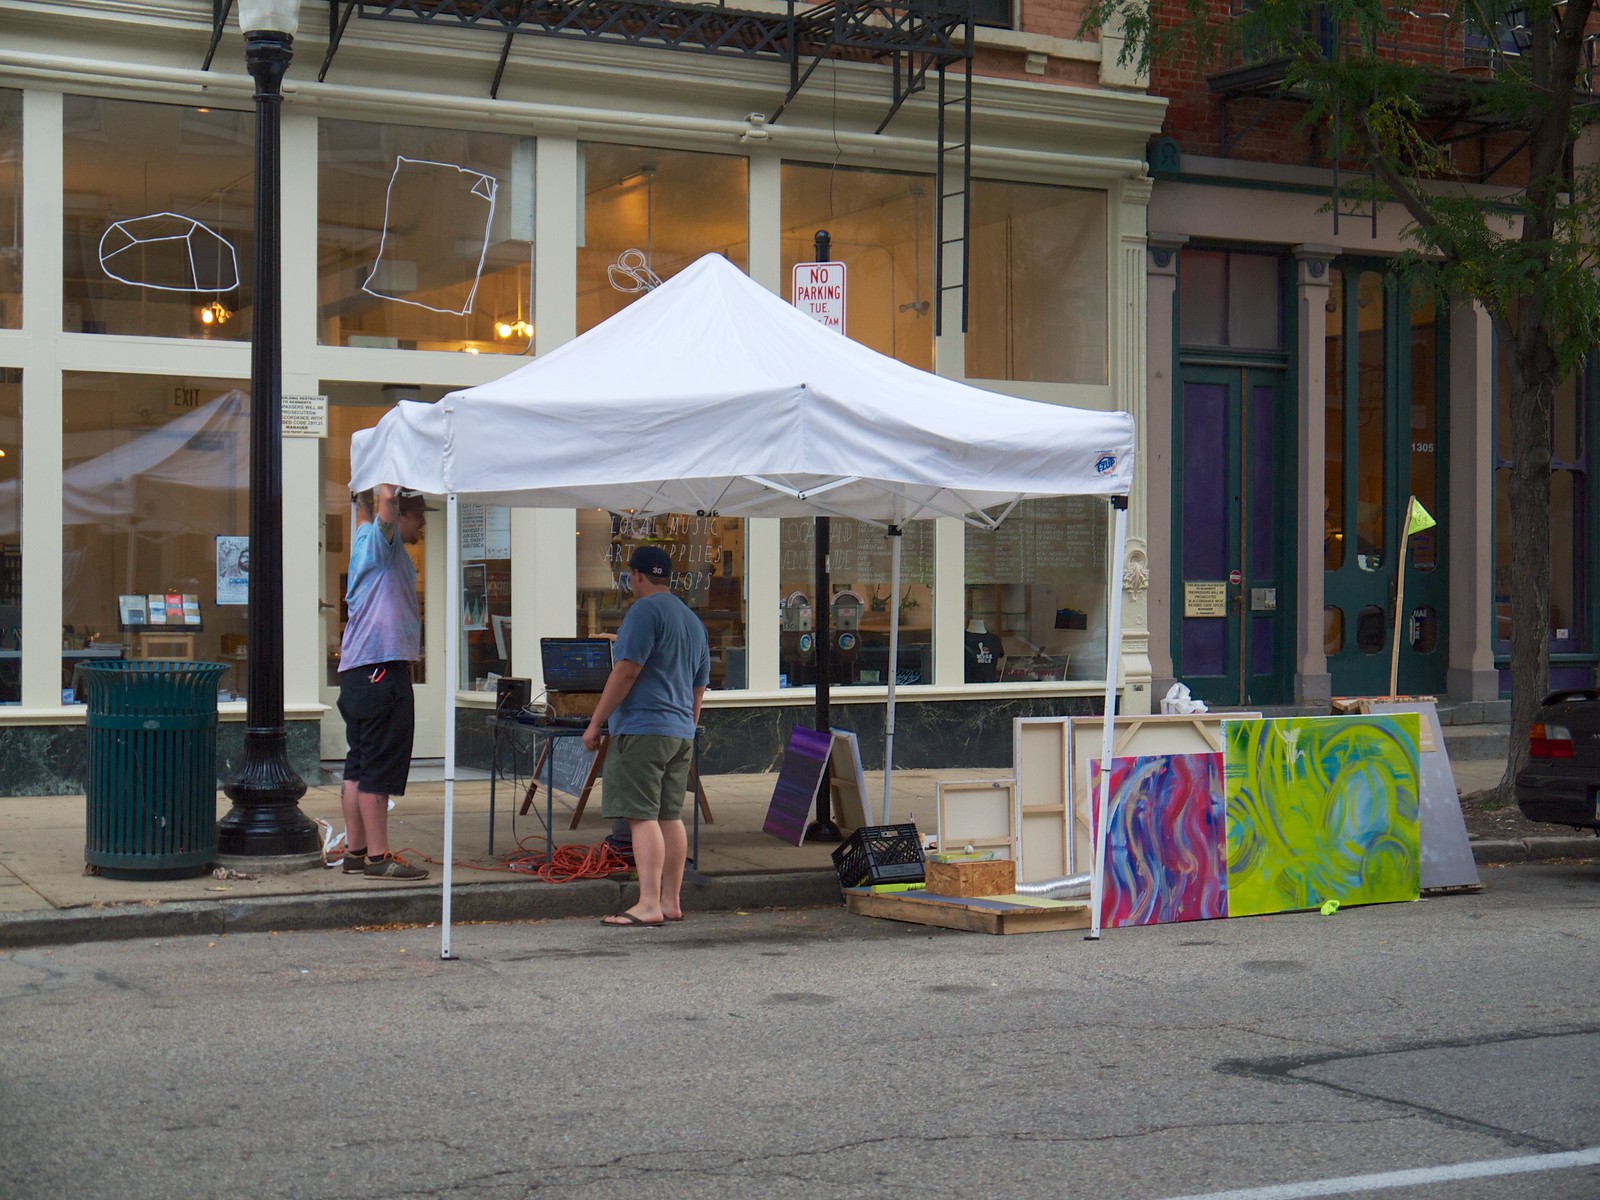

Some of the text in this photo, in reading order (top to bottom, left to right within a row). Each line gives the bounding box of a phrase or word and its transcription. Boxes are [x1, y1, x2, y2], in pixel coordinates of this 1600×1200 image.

[810, 268, 828, 283] NO
[798, 286, 840, 300] PARKING
[810, 303, 830, 313] TUE.
[175, 388, 200, 407] EXIT
[1411, 442, 1434, 452] 1305
[610, 516, 718, 535] LOCAL MUSIC
[781, 521, 852, 544] LOCA AND
[604, 543, 722, 563] ART PPLIES
[652, 567, 663, 575] 30
[611, 571, 712, 593] WOHOPS
